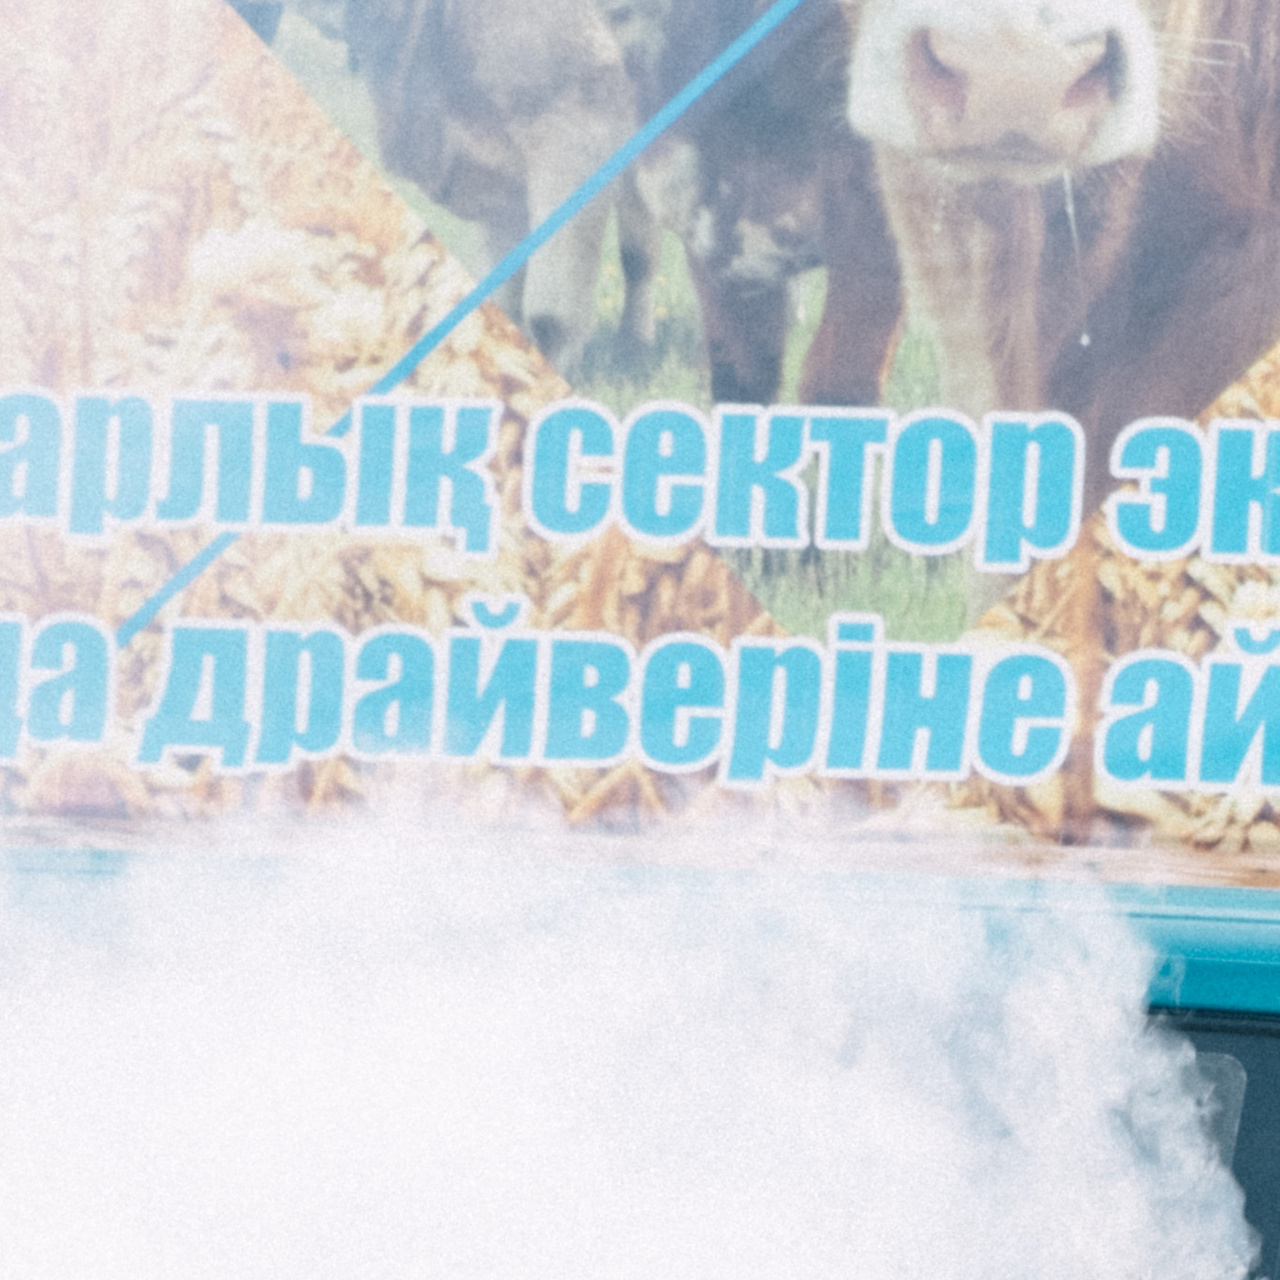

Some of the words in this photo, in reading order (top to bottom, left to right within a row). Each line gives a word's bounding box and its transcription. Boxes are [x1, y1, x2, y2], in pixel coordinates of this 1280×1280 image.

[0, 391, 498, 554] арлық
[529, 404, 1079, 566] сектор
[0, 619, 112, 759] а
[135, 602, 1072, 781] драйверіне
